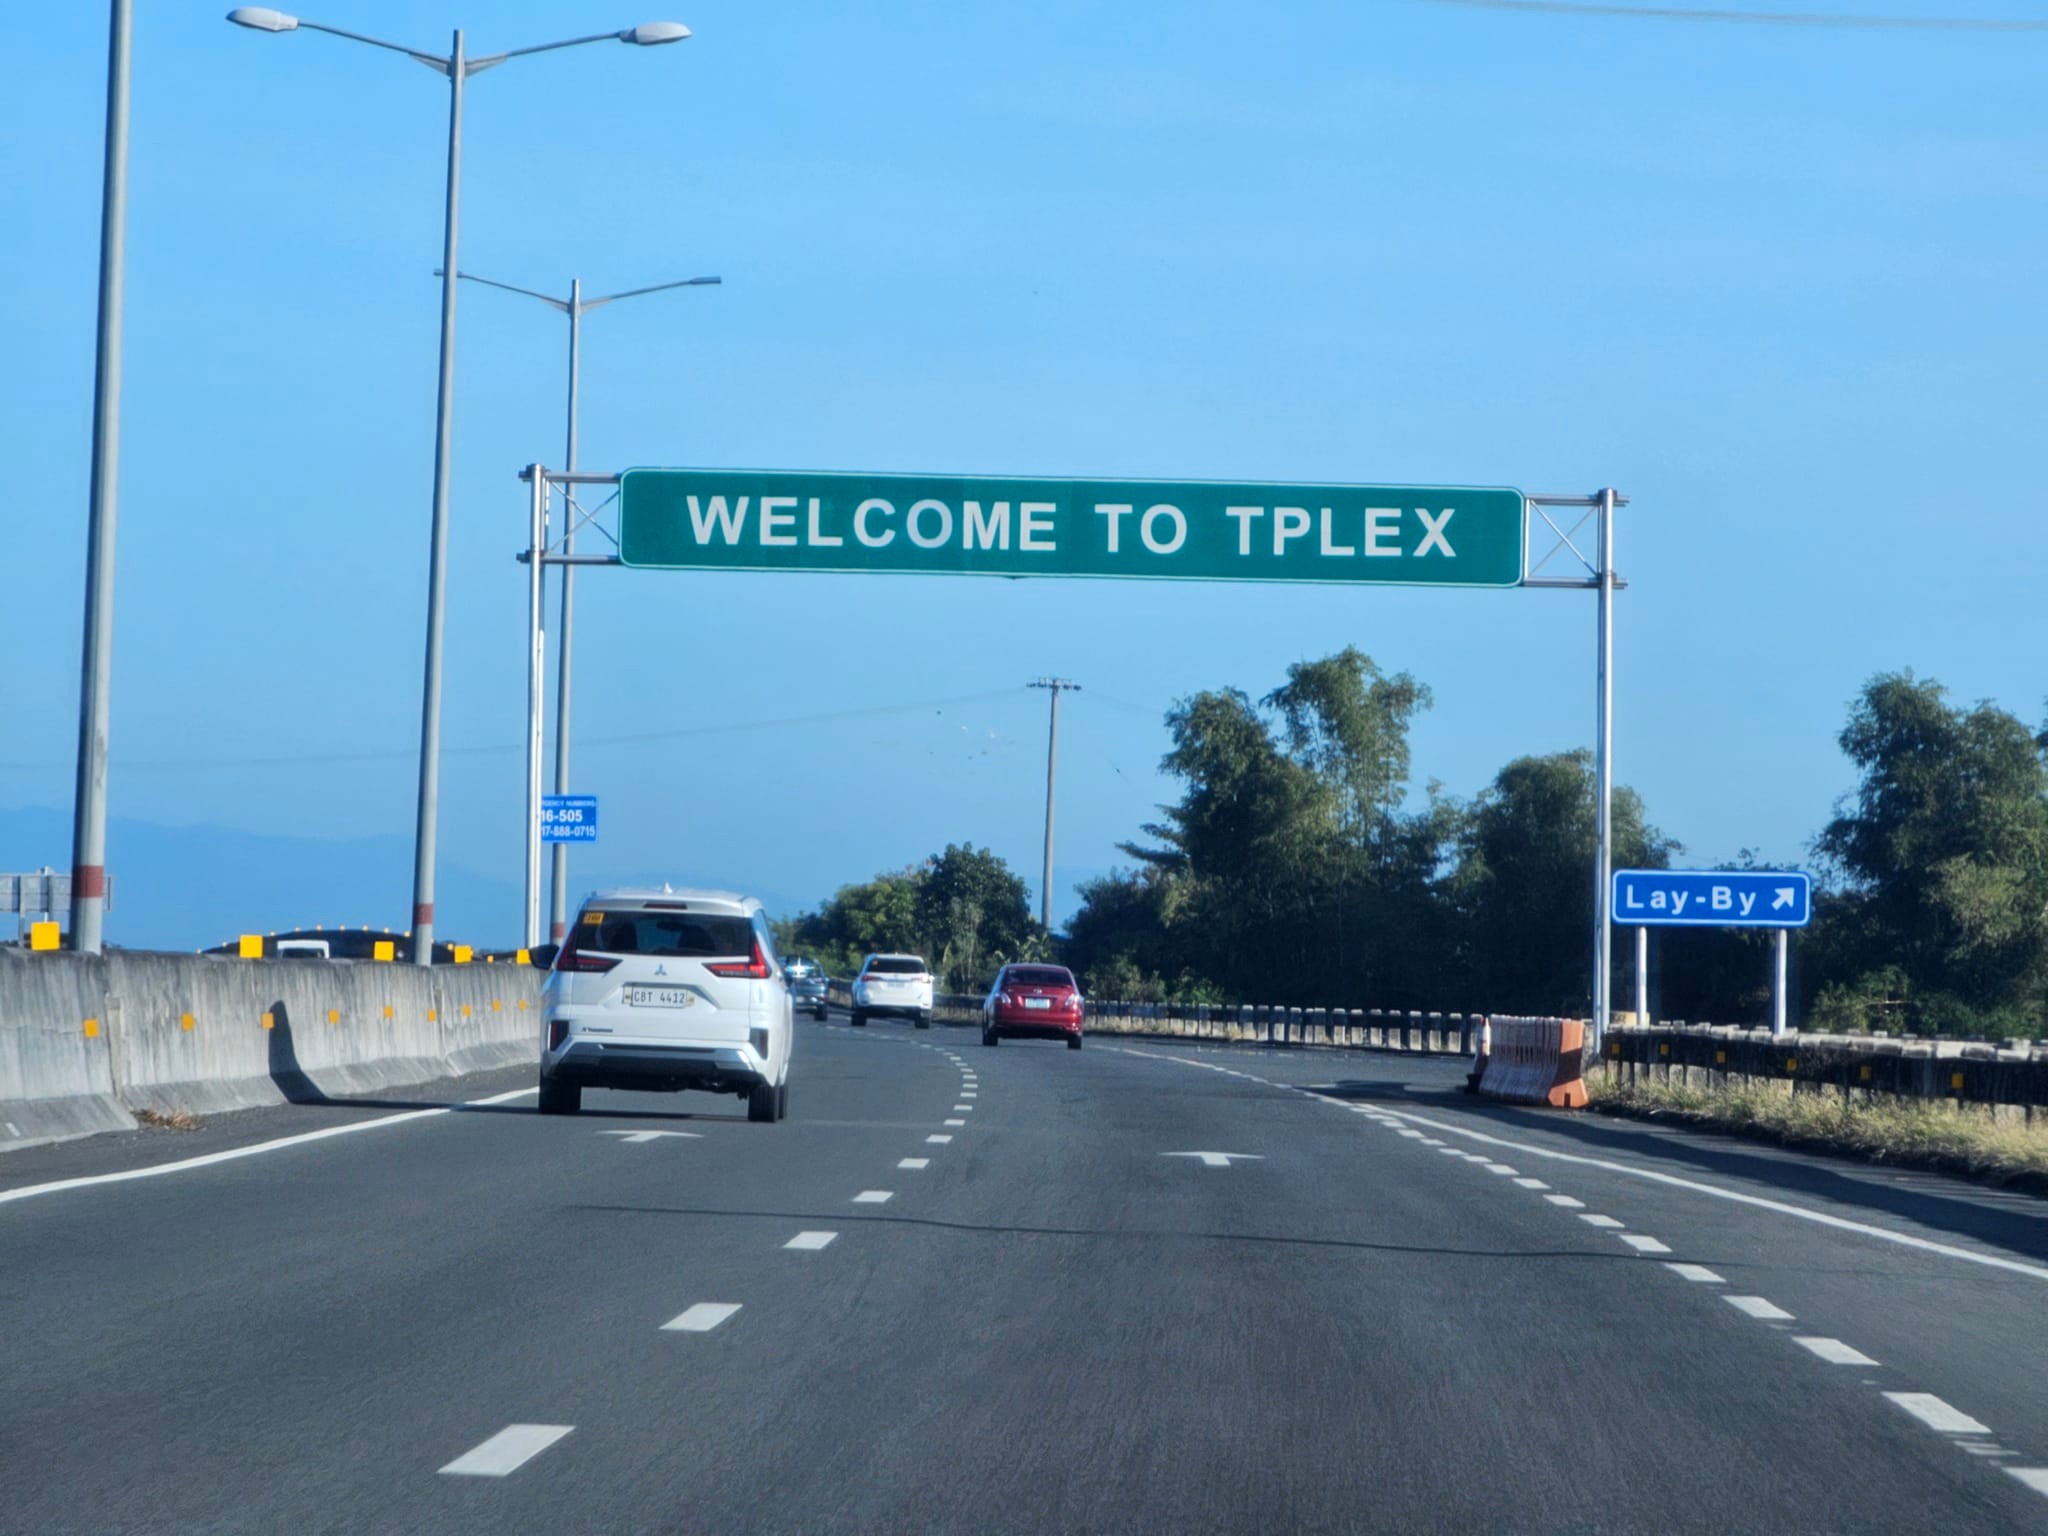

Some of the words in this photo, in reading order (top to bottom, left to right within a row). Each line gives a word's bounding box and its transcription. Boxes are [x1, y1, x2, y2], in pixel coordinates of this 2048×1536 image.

[686, 494, 1057, 552] WELCOME
[1094, 503, 1188, 555] TO
[1225, 506, 1457, 558] TPLEX
[1626, 884, 1757, 917] Lay-By
